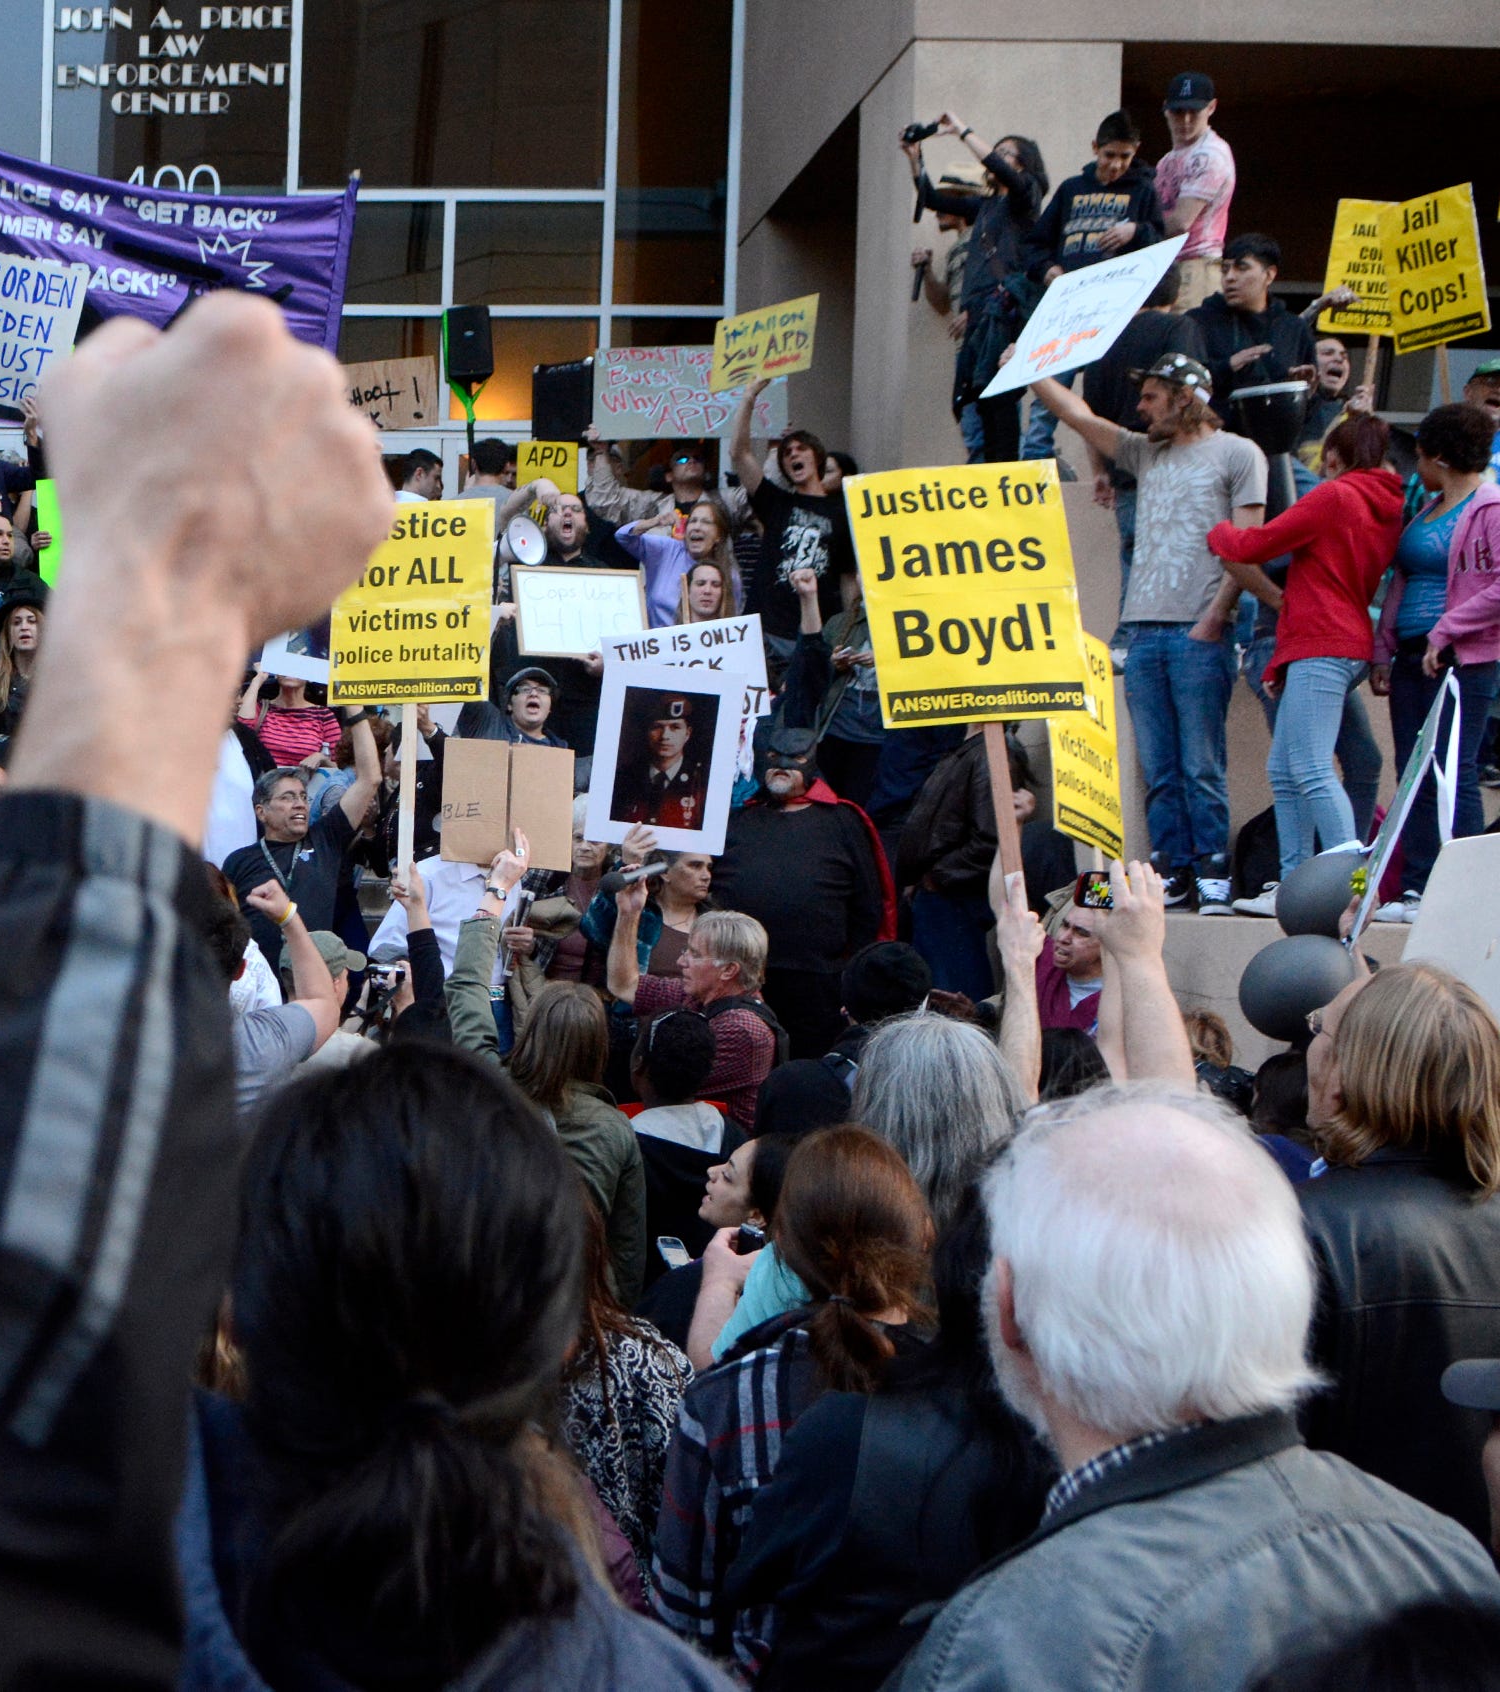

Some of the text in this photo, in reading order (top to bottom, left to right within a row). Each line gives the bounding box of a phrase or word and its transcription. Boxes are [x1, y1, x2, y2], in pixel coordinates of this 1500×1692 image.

[54, 6, 291, 31] JOHN A. PRICE
[138, 34, 204, 58] LAW
[57, 63, 290, 87] ENFORCEMENT
[111, 91, 230, 115] CENTER
[58, 188, 111, 217] SAY
[1401, 199, 1440, 235] Jail
[56, 221, 107, 250] SAY
[1396, 237, 1459, 274] Killer
[1399, 272, 1469, 316] Cops!
[601, 389, 663, 416] Why
[652, 402, 731, 435] APD
[525, 446, 569, 467] APD
[861, 475, 1049, 519] Justice for
[406, 556, 464, 585] ALL
[877, 535, 1047, 582] James
[348, 604, 471, 633] victims of
[613, 623, 749, 661] THIS IS ONLY
[893, 602, 1057, 667] Boyd!
[334, 642, 485, 669] police brutality
[338, 682, 477, 697] ANSWERcoalition.org
[891, 690, 1084, 714] ANSWERcoalition.org
